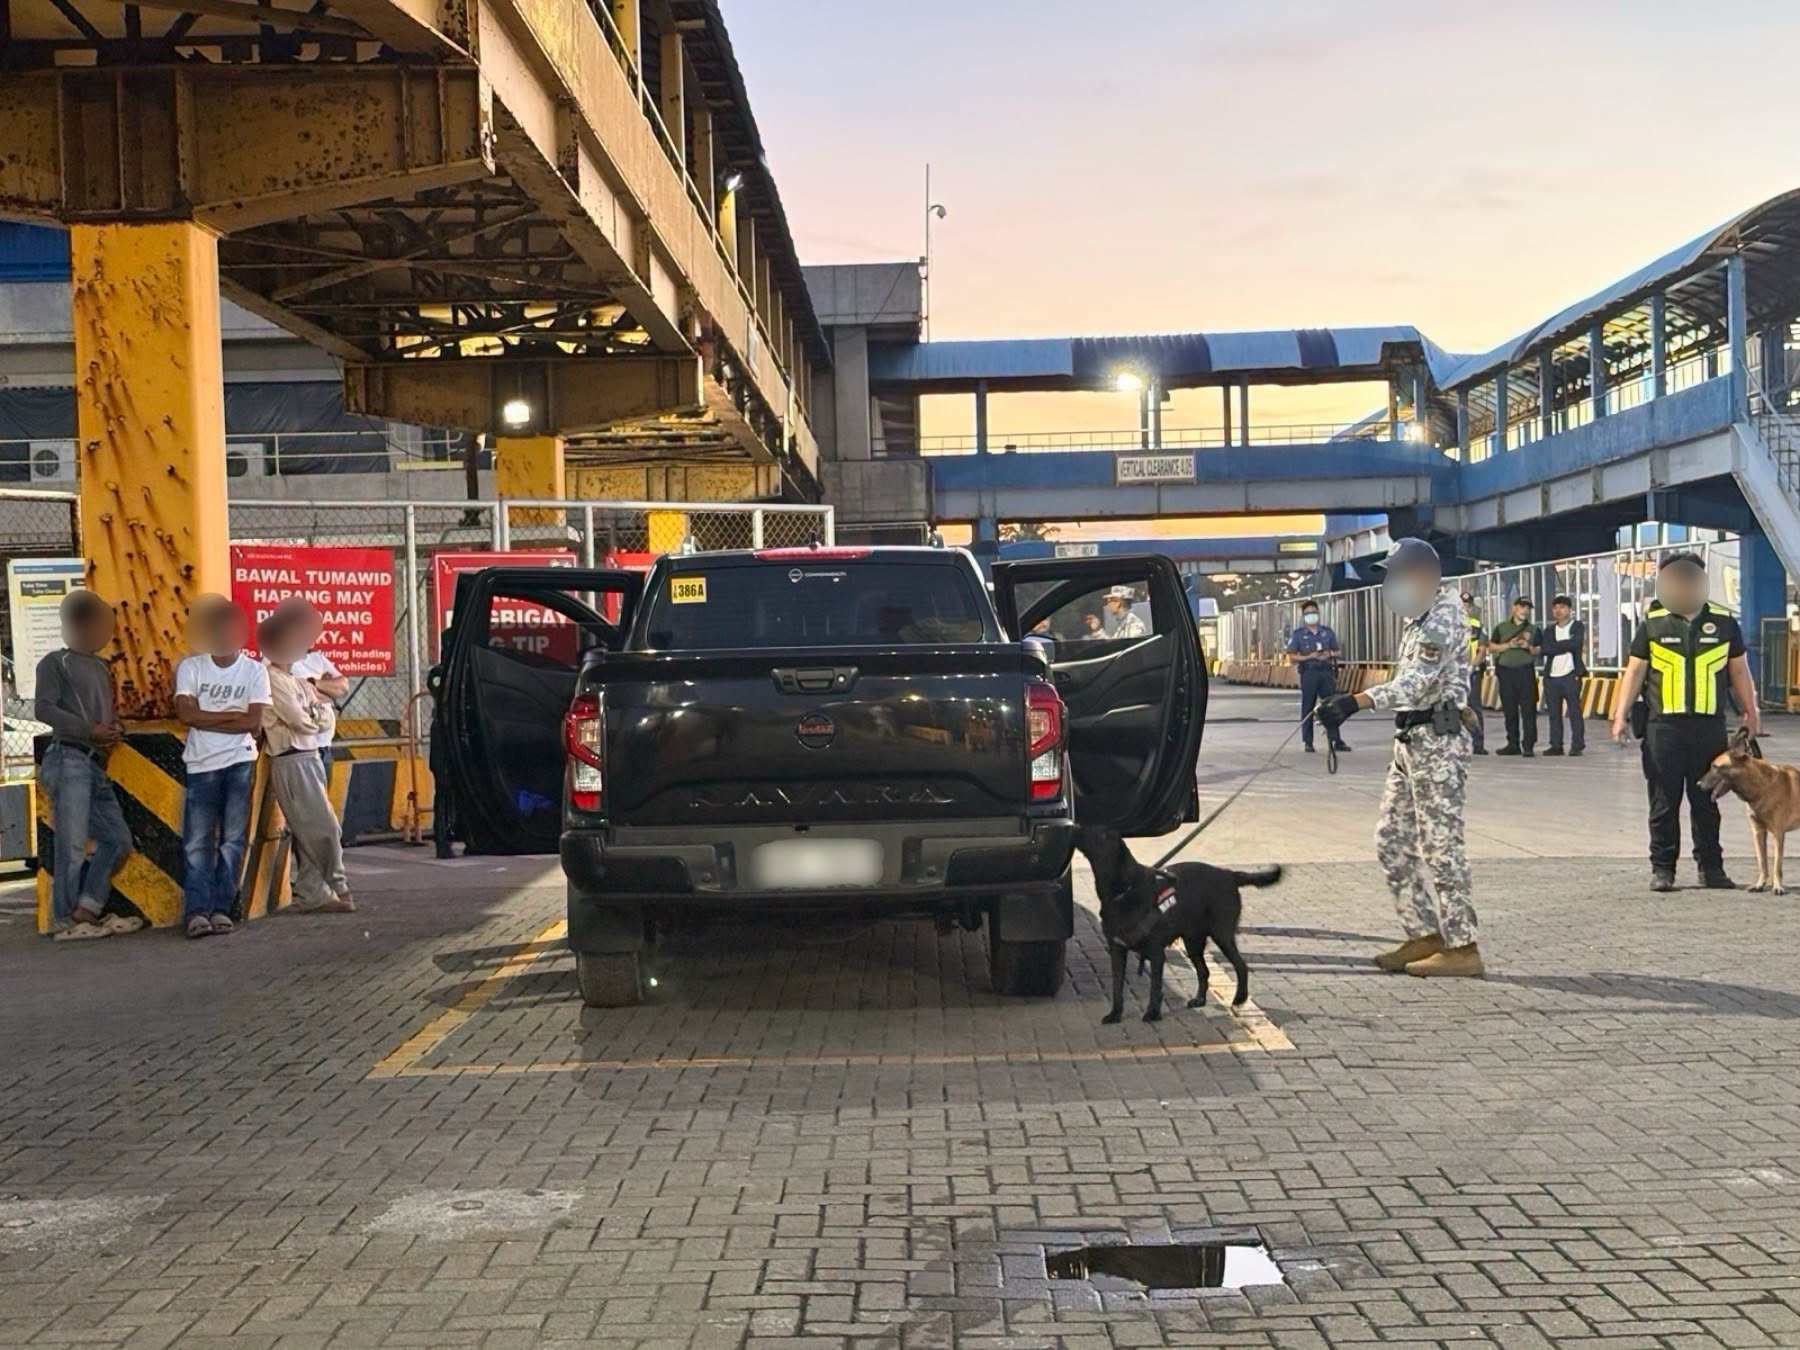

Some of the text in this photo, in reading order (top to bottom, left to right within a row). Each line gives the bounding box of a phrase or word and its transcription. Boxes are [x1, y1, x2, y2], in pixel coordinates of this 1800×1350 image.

[1119, 460, 1146, 478] VERTICAL
[1147, 459, 1180, 476] CLEARANCE
[235, 568, 392, 586] BAWAL TUMAWID
[336, 590, 375, 605] MAY
[678, 583, 704, 598] 386A
[511, 635, 550, 654] TIP
[352, 651, 392, 661] loading
[339, 662, 387, 672] vehicles)
[200, 684, 245, 699] FUBU
